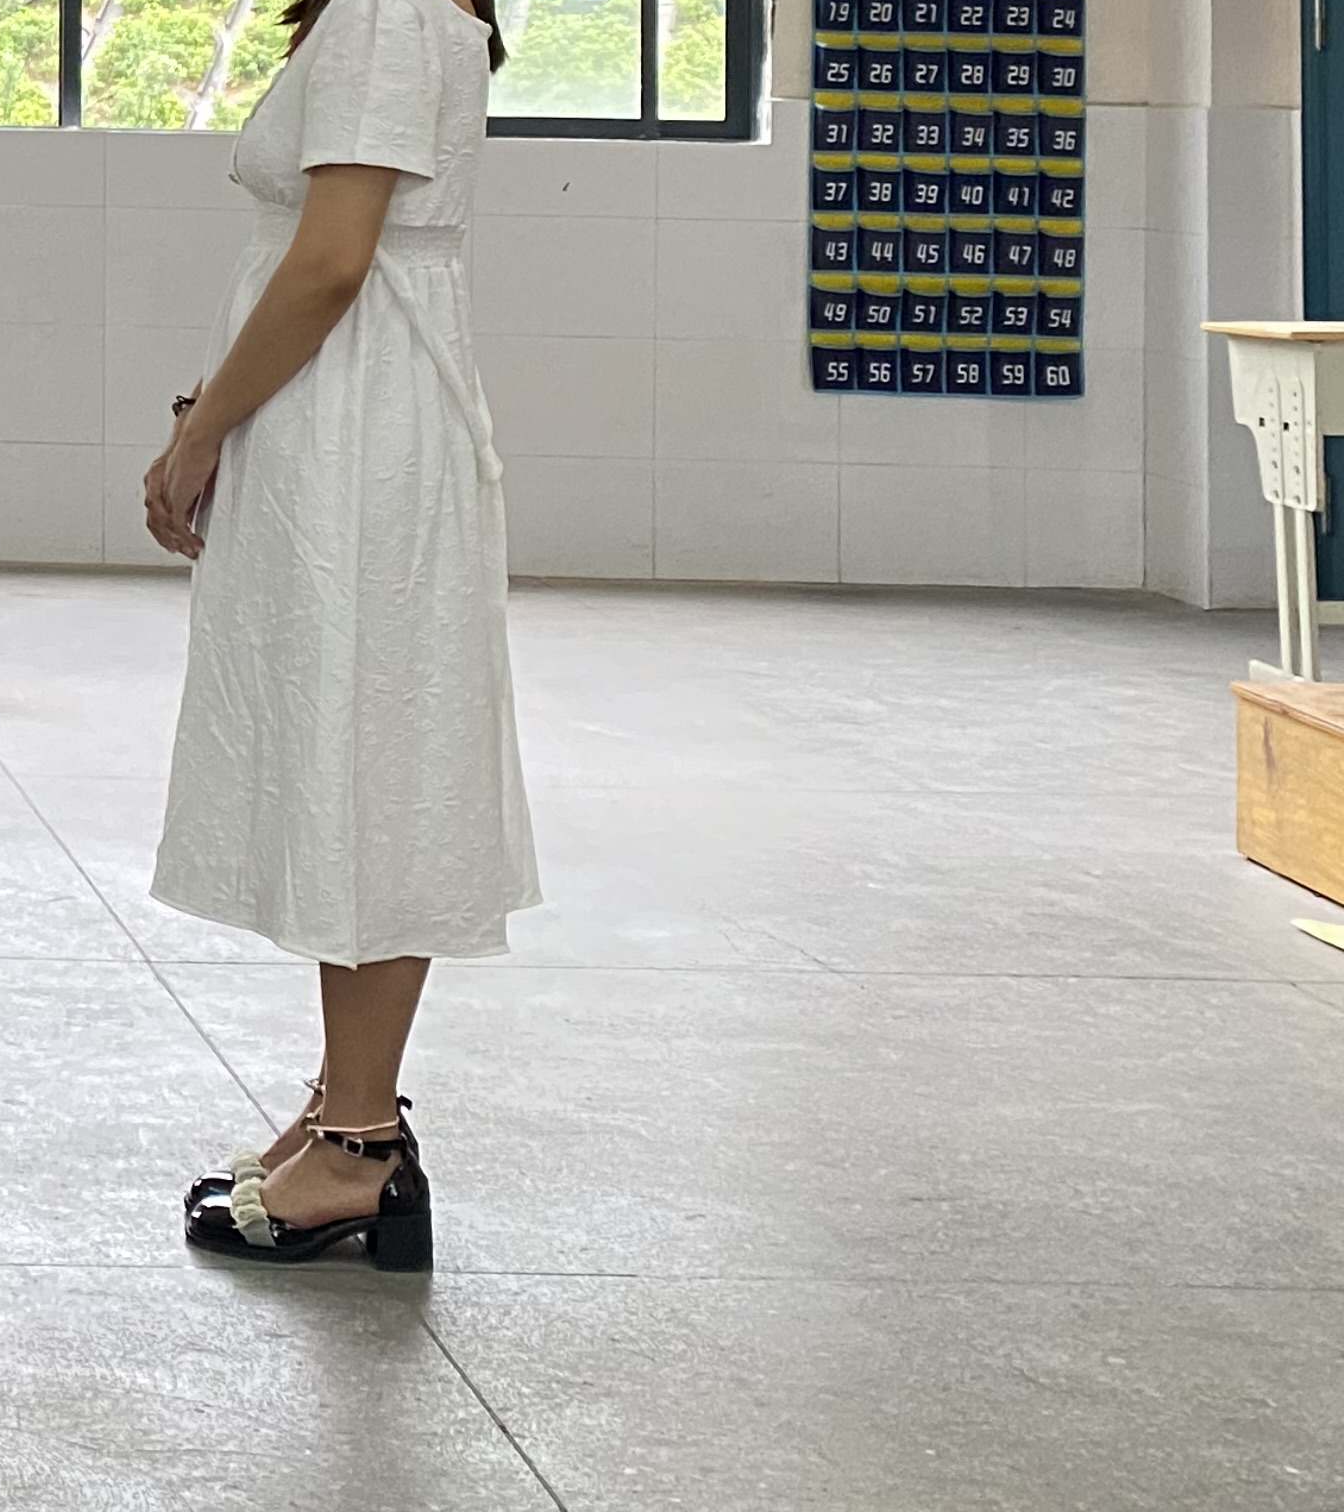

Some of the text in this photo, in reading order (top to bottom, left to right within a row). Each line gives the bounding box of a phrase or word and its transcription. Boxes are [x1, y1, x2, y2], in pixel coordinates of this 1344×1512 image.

[829, 1, 1075, 28] 19 20 21 22 23 24
[826, 62, 1076, 87] 25 26 27 28 29 30
[826, 123, 1077, 151] 31 32 33 34 35 36
[824, 181, 1074, 208] 37 38 39 40 41 42
[825, 241, 1076, 268] 43 44 45 46 47 48
[824, 302, 1072, 328] 49 50 51 52 53 54
[826, 361, 1071, 386] 55 56 57 58 59 60
